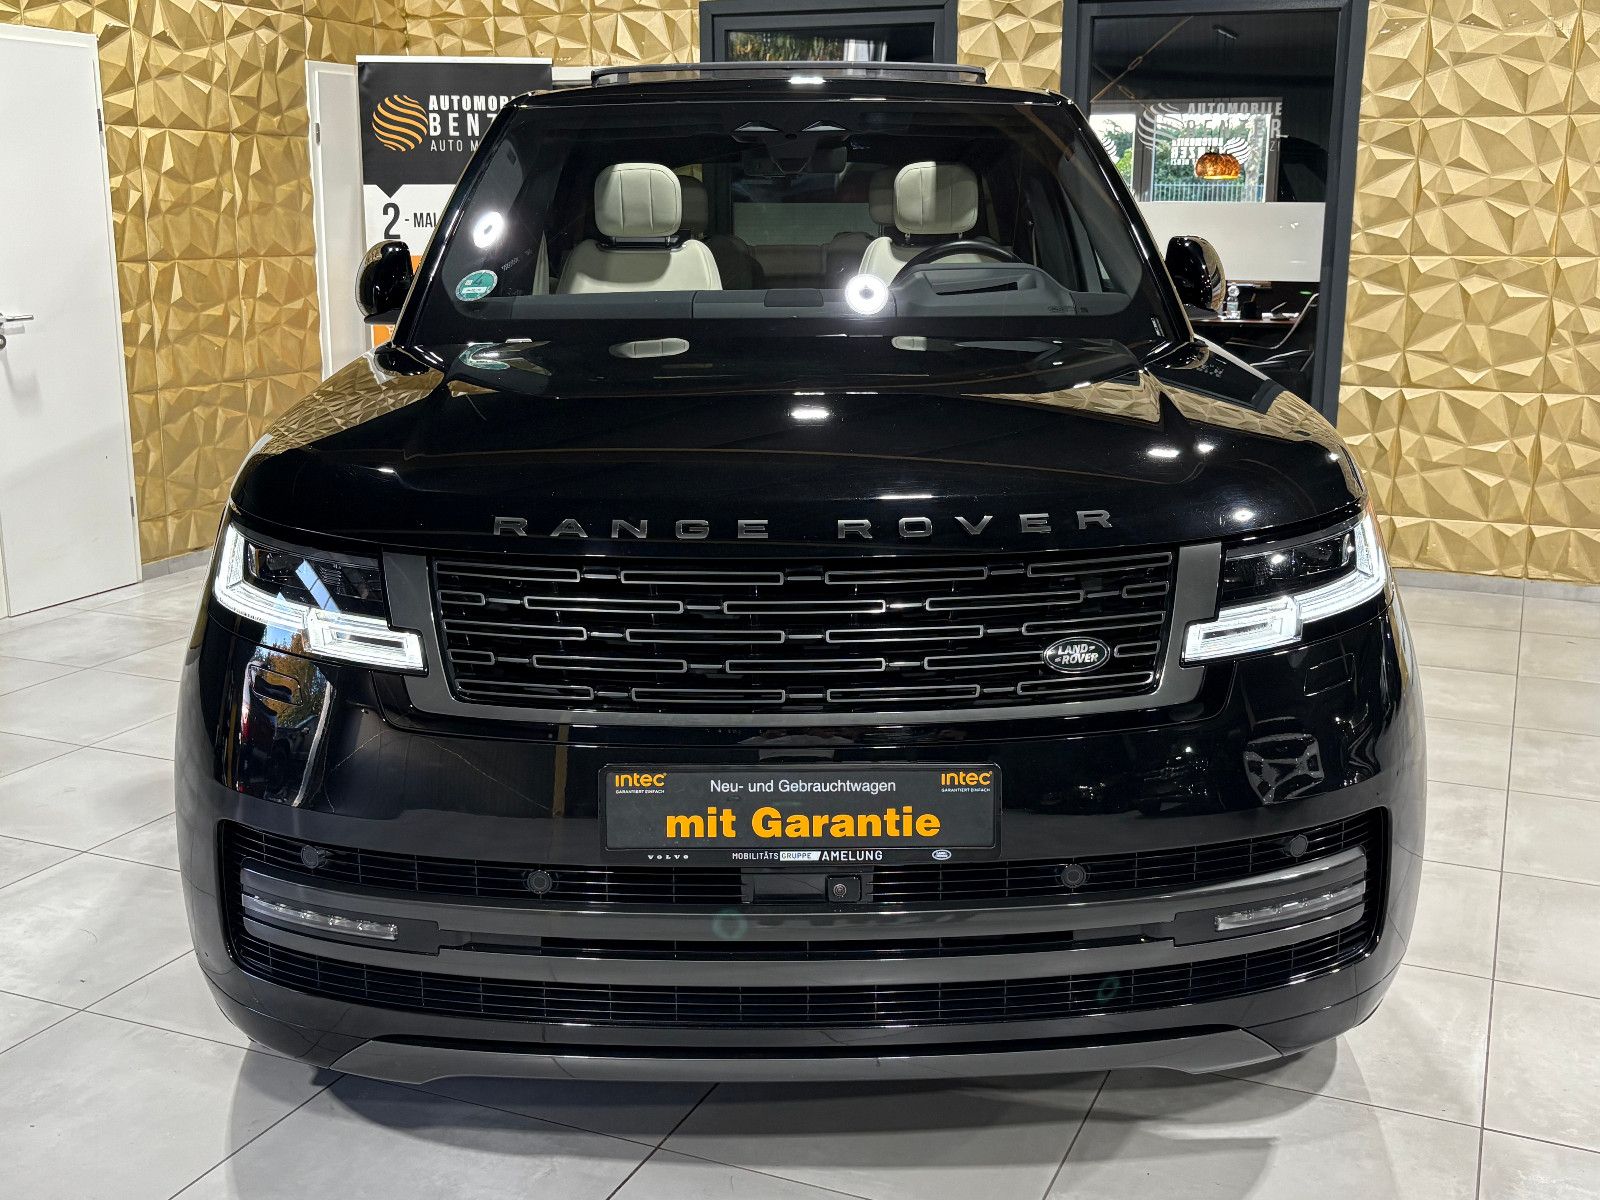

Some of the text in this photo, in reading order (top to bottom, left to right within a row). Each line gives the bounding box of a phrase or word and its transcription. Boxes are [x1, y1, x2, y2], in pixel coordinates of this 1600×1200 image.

[428, 94, 516, 111] AUTOMOB
[1187, 102, 1282, 116] AUTOMOBILE
[430, 140, 463, 152] AUTO
[382, 202, 401, 239] 2
[493, 509, 1113, 539] RANGE ROVER
[1057, 643, 1089, 655] LAND
[1061, 652, 1099, 665] ROVER
[615, 772, 666, 788] intec
[941, 771, 992, 786] intec
[710, 779, 897, 796] Neu- und Gebrauchtwagen
[666, 805, 941, 838] mit Garantie
[822, 850, 883, 861] AMELUNG
